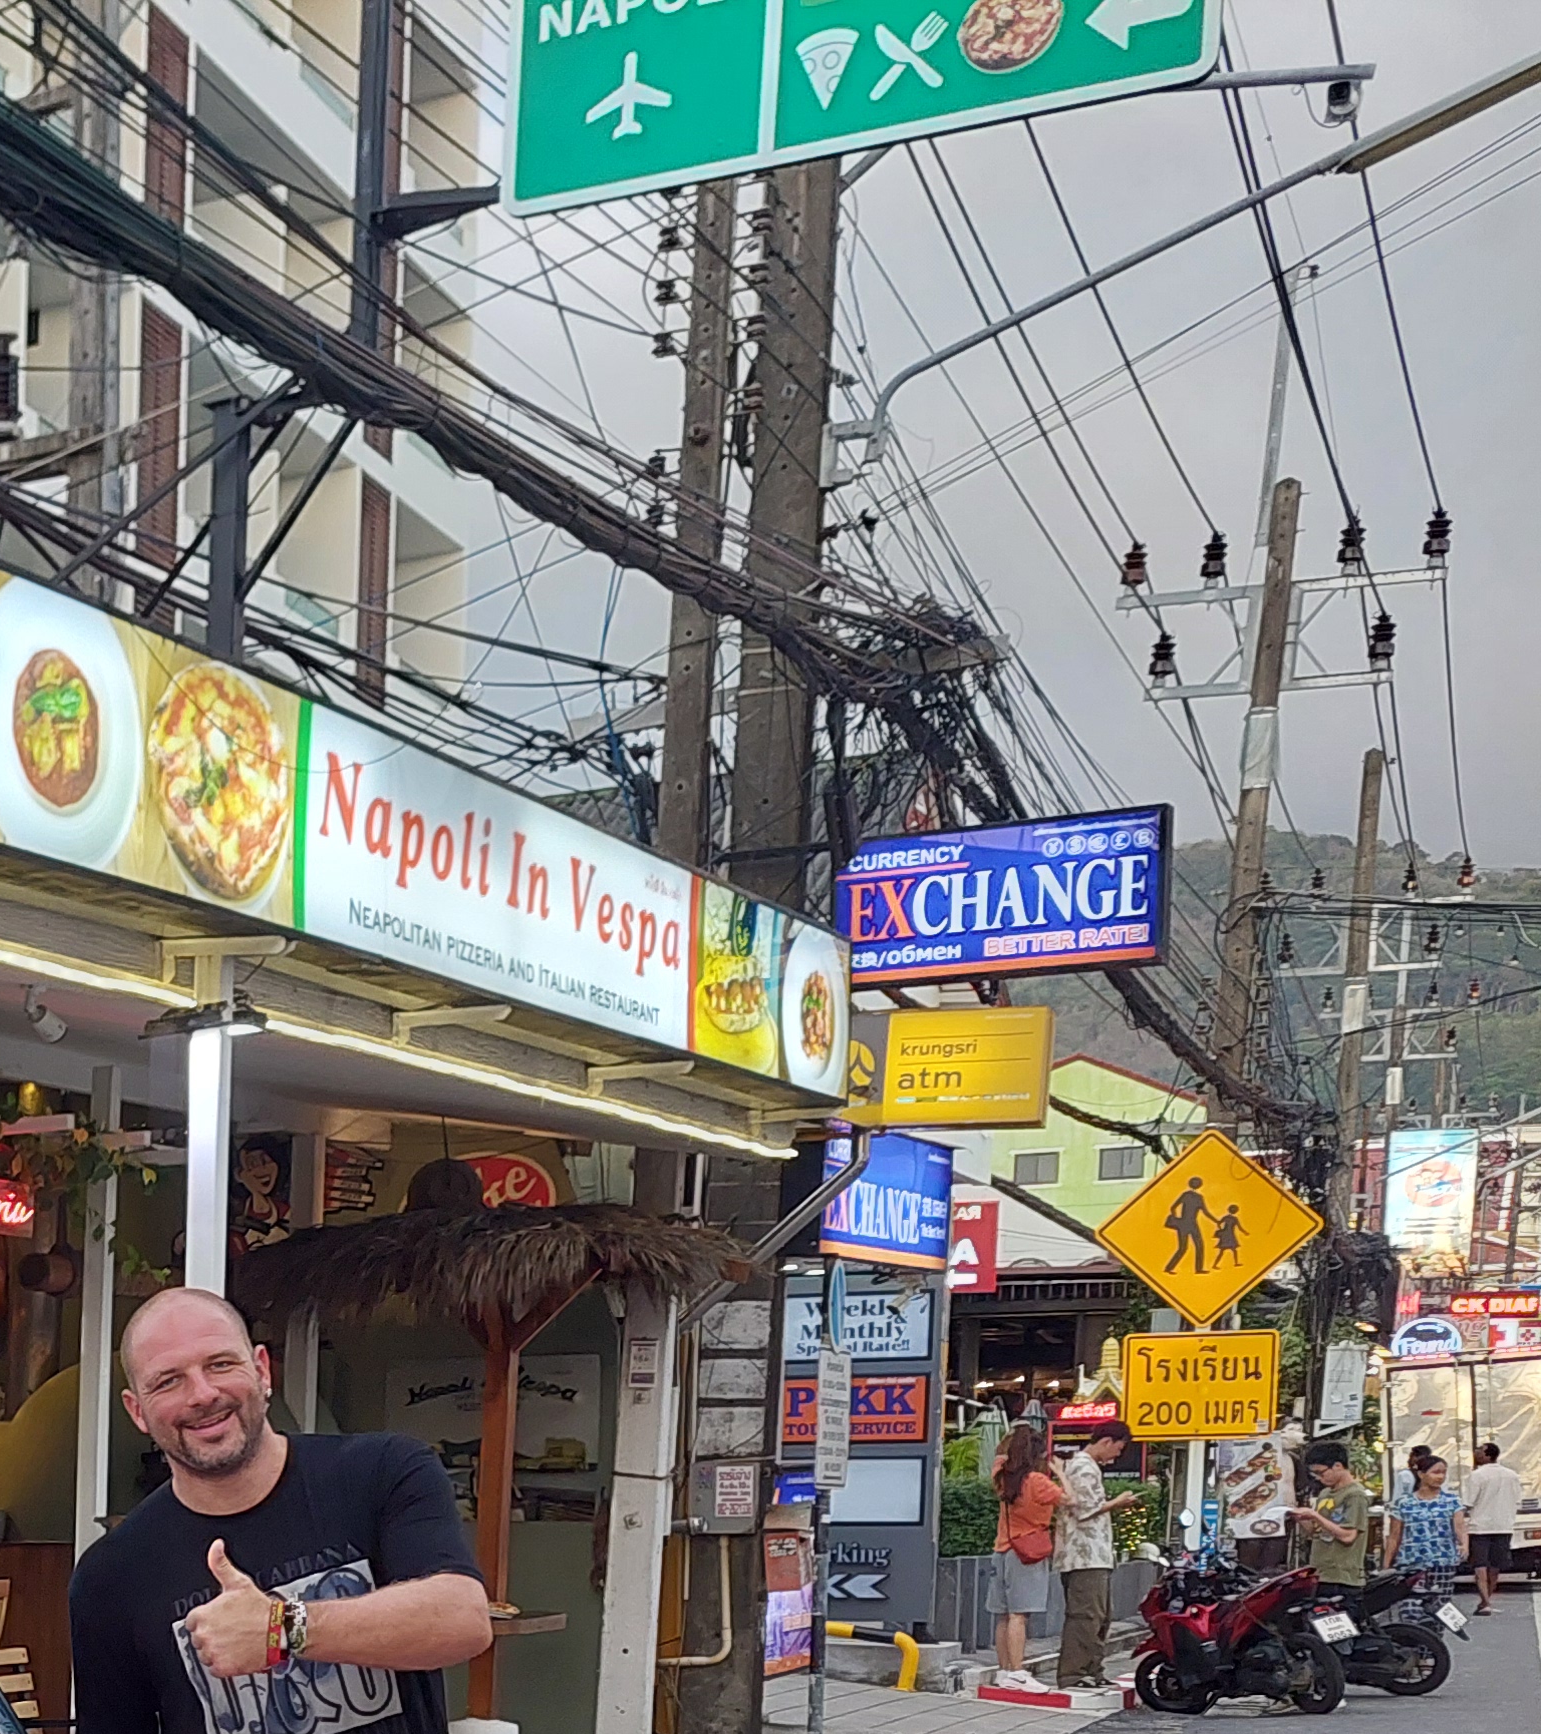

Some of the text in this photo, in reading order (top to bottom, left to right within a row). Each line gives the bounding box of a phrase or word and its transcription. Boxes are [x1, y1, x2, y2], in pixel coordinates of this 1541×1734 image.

[538, 0, 724, 44] NAP
[319, 751, 682, 977] Napoli In Vespa
[848, 844, 965, 873] CURRENCY
[848, 854, 1150, 943] EXCHANGE
[983, 922, 1150, 957] BETTER RATE!
[348, 898, 661, 1027] NEAPOLITAN PIZZERIA AND ITALIAN RESTAURANT
[900, 1039, 978, 1058] krungsri
[898, 1067, 962, 1091] atm
[1451, 1297, 1487, 1314] CK
[799, 1320, 908, 1342] Mnthly
[1136, 1344, 1263, 1383] โรงเรียน
[1137, 1400, 1193, 1427] 200
[1204, 1399, 1261, 1425] เมตร
[849, 1421, 917, 1435] ERVICE
